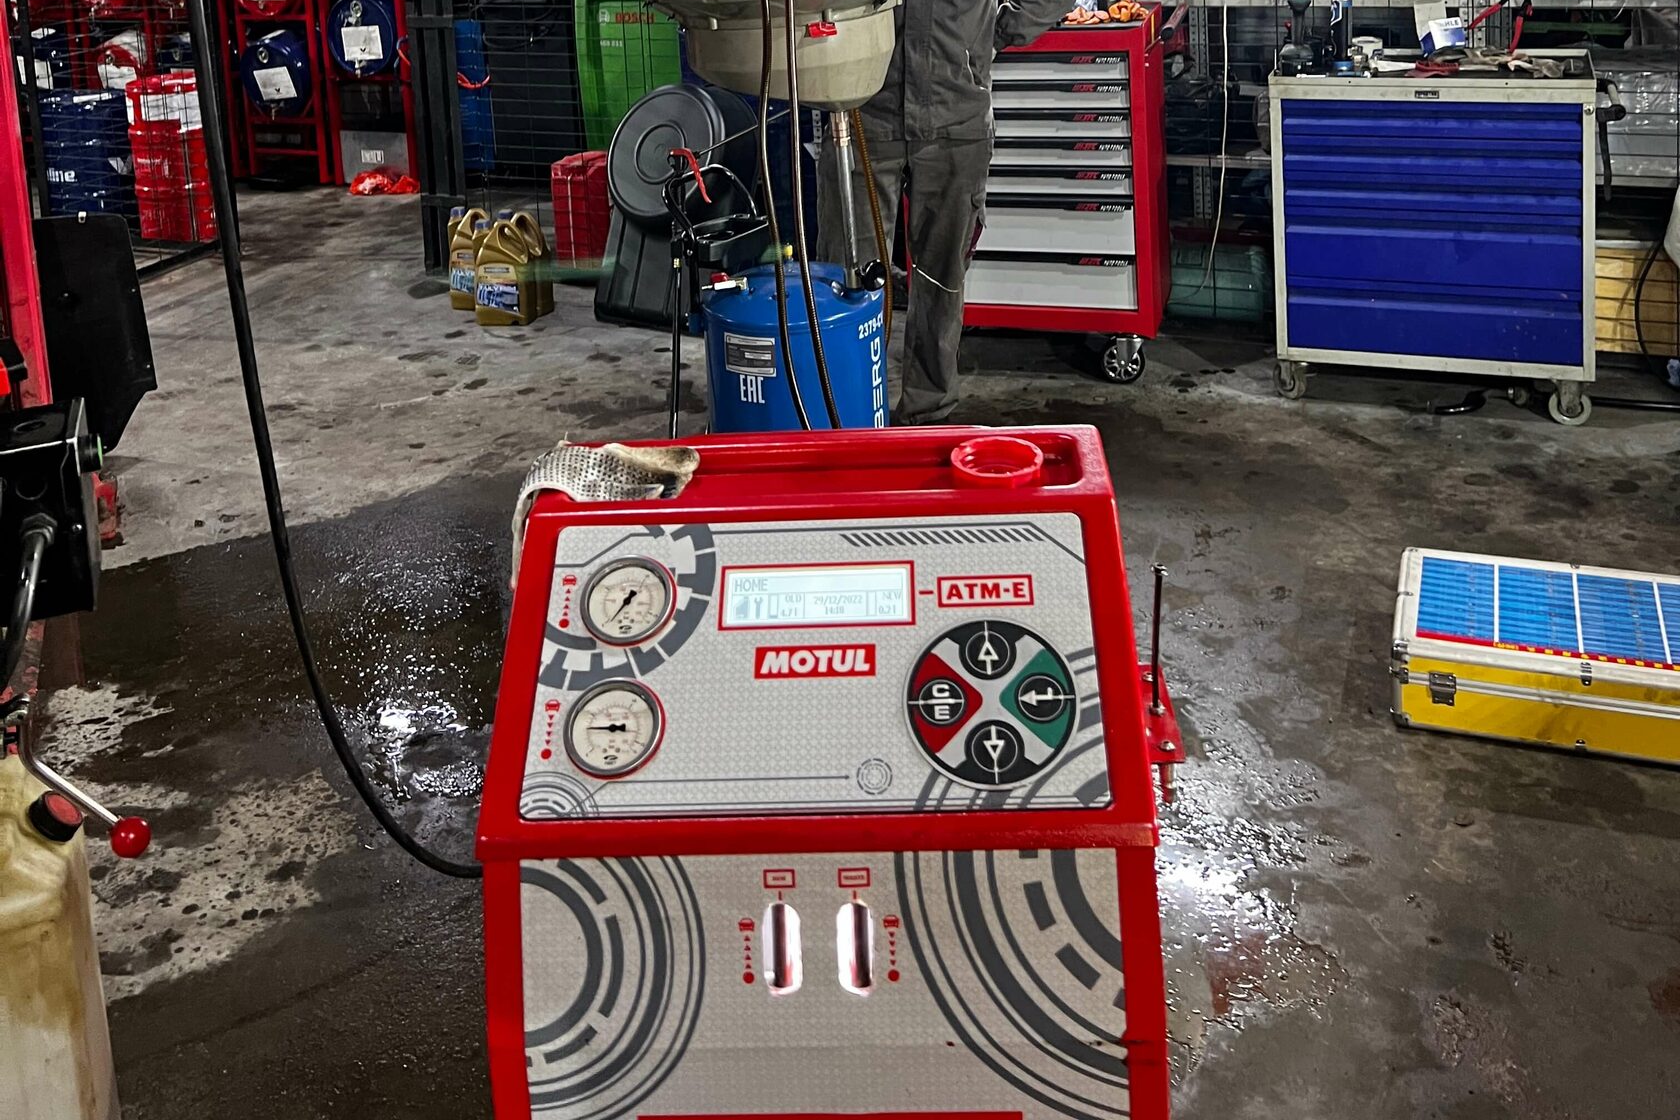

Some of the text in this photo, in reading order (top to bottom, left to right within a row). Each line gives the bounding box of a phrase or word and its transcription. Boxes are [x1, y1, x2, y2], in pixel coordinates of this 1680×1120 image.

[734, 579, 768, 593] HOME
[946, 582, 1027, 601] ATM-E
[759, 649, 871, 674] MOTUL
